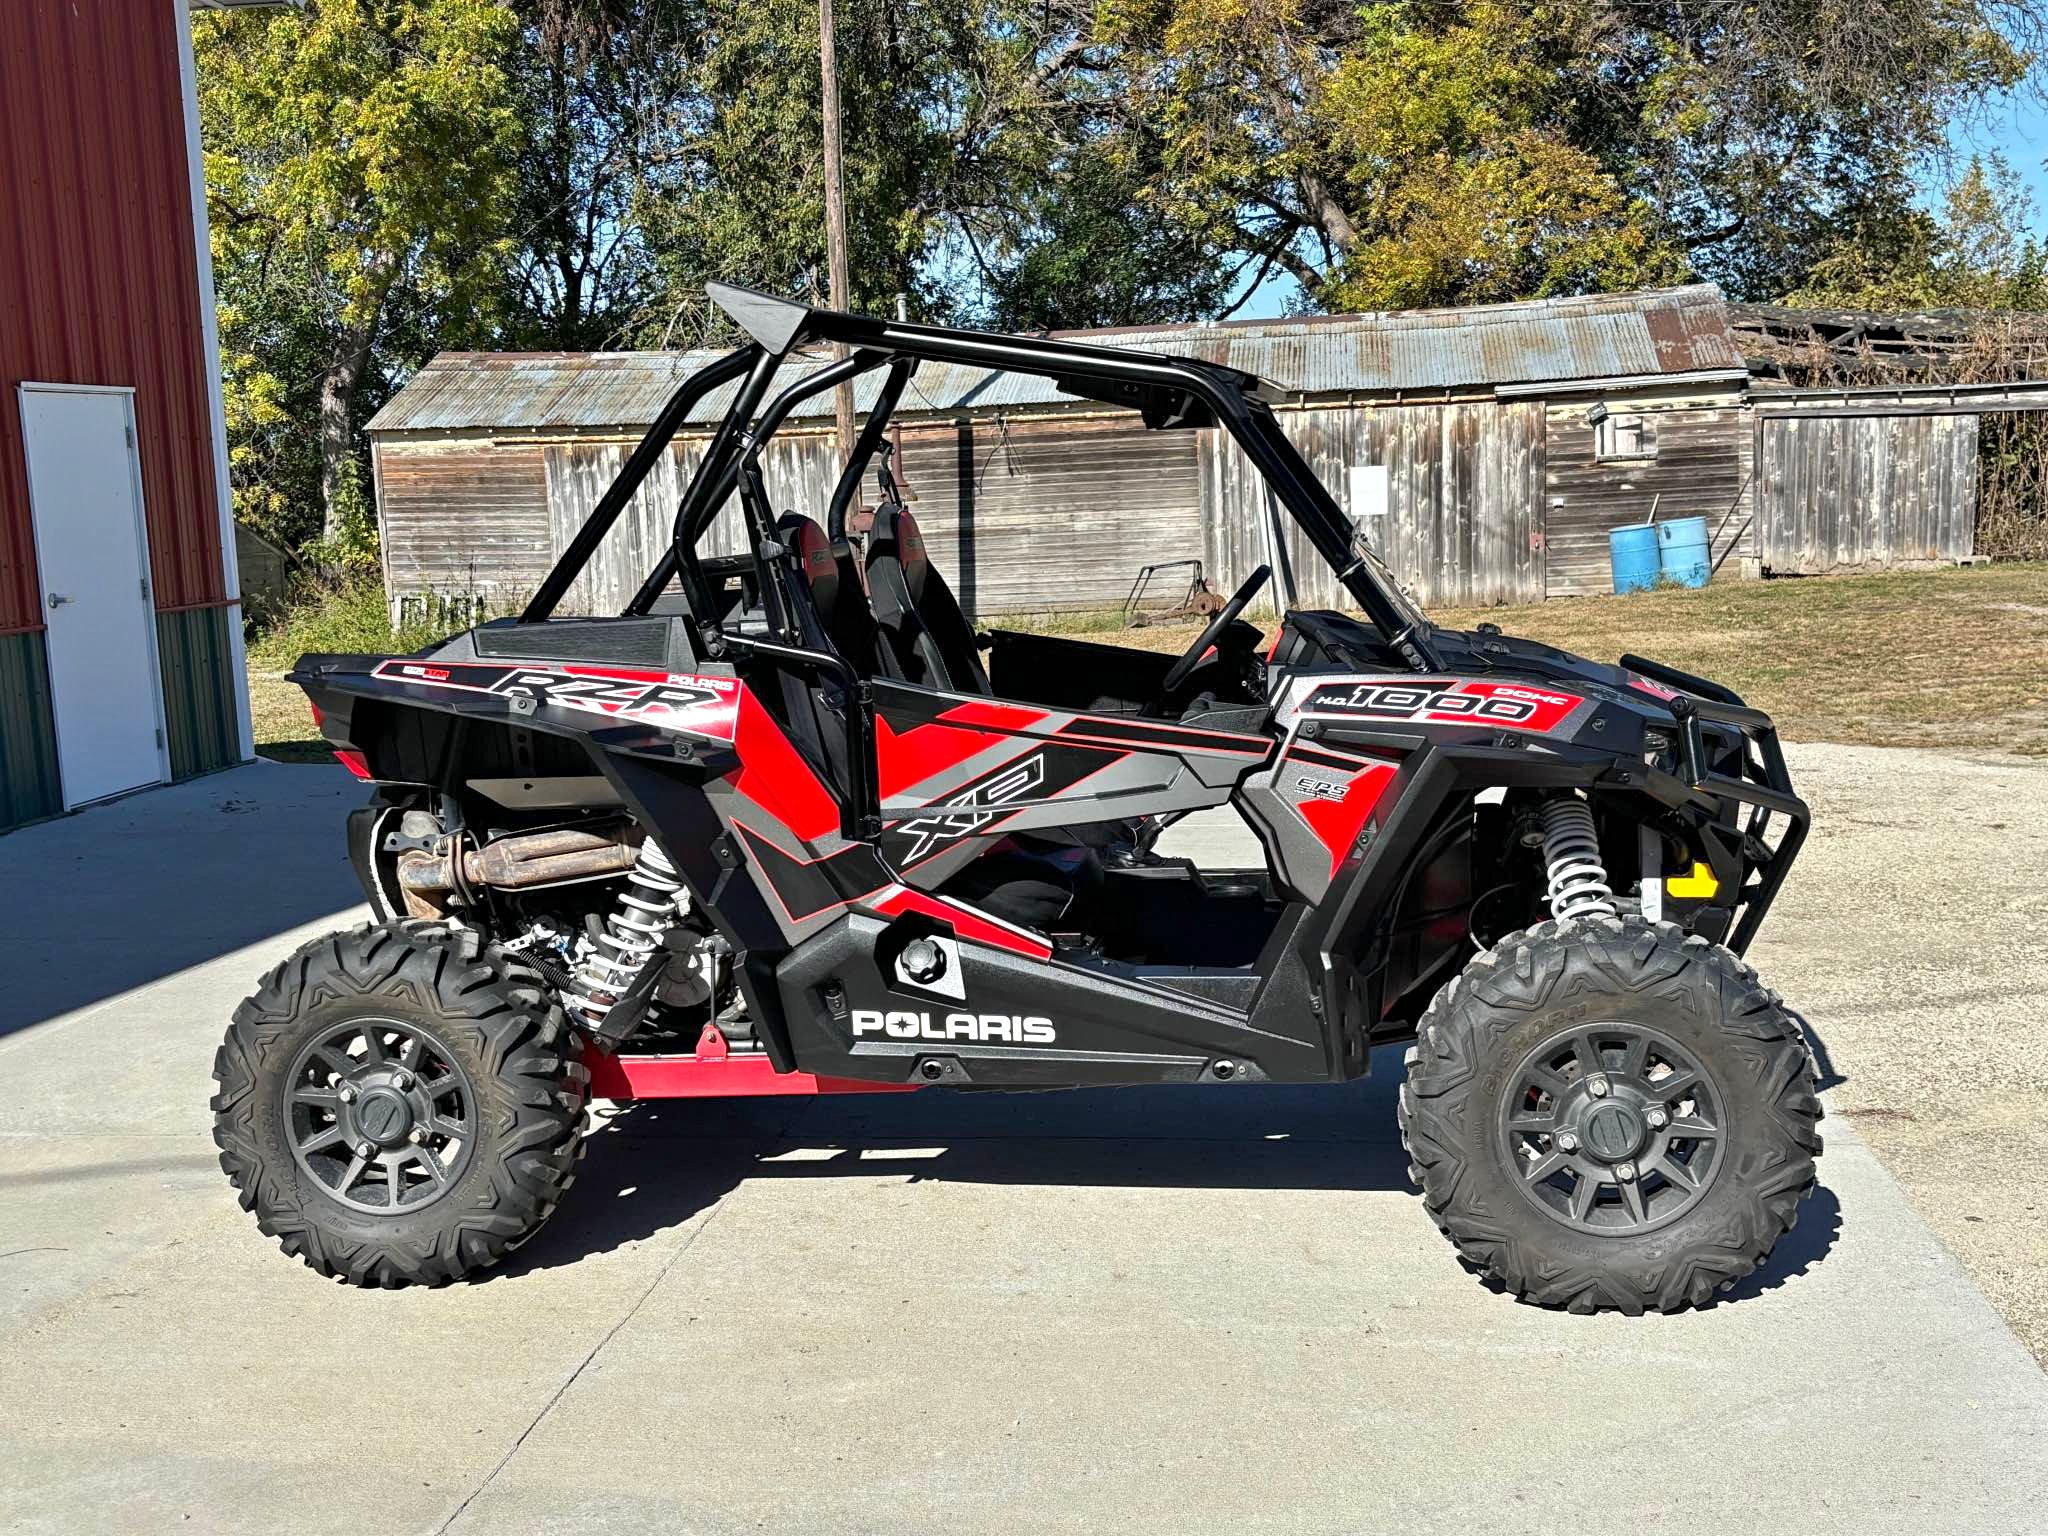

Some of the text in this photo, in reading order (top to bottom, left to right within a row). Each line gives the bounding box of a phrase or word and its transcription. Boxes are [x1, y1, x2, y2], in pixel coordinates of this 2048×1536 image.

[489, 668, 724, 716] RZR
[667, 674, 734, 692] POLARIS
[1491, 687, 1569, 706] DOHC
[1347, 685, 1538, 723] 1000
[1295, 776, 1351, 797] EPS
[851, 1009, 1057, 1044] POLARIS
